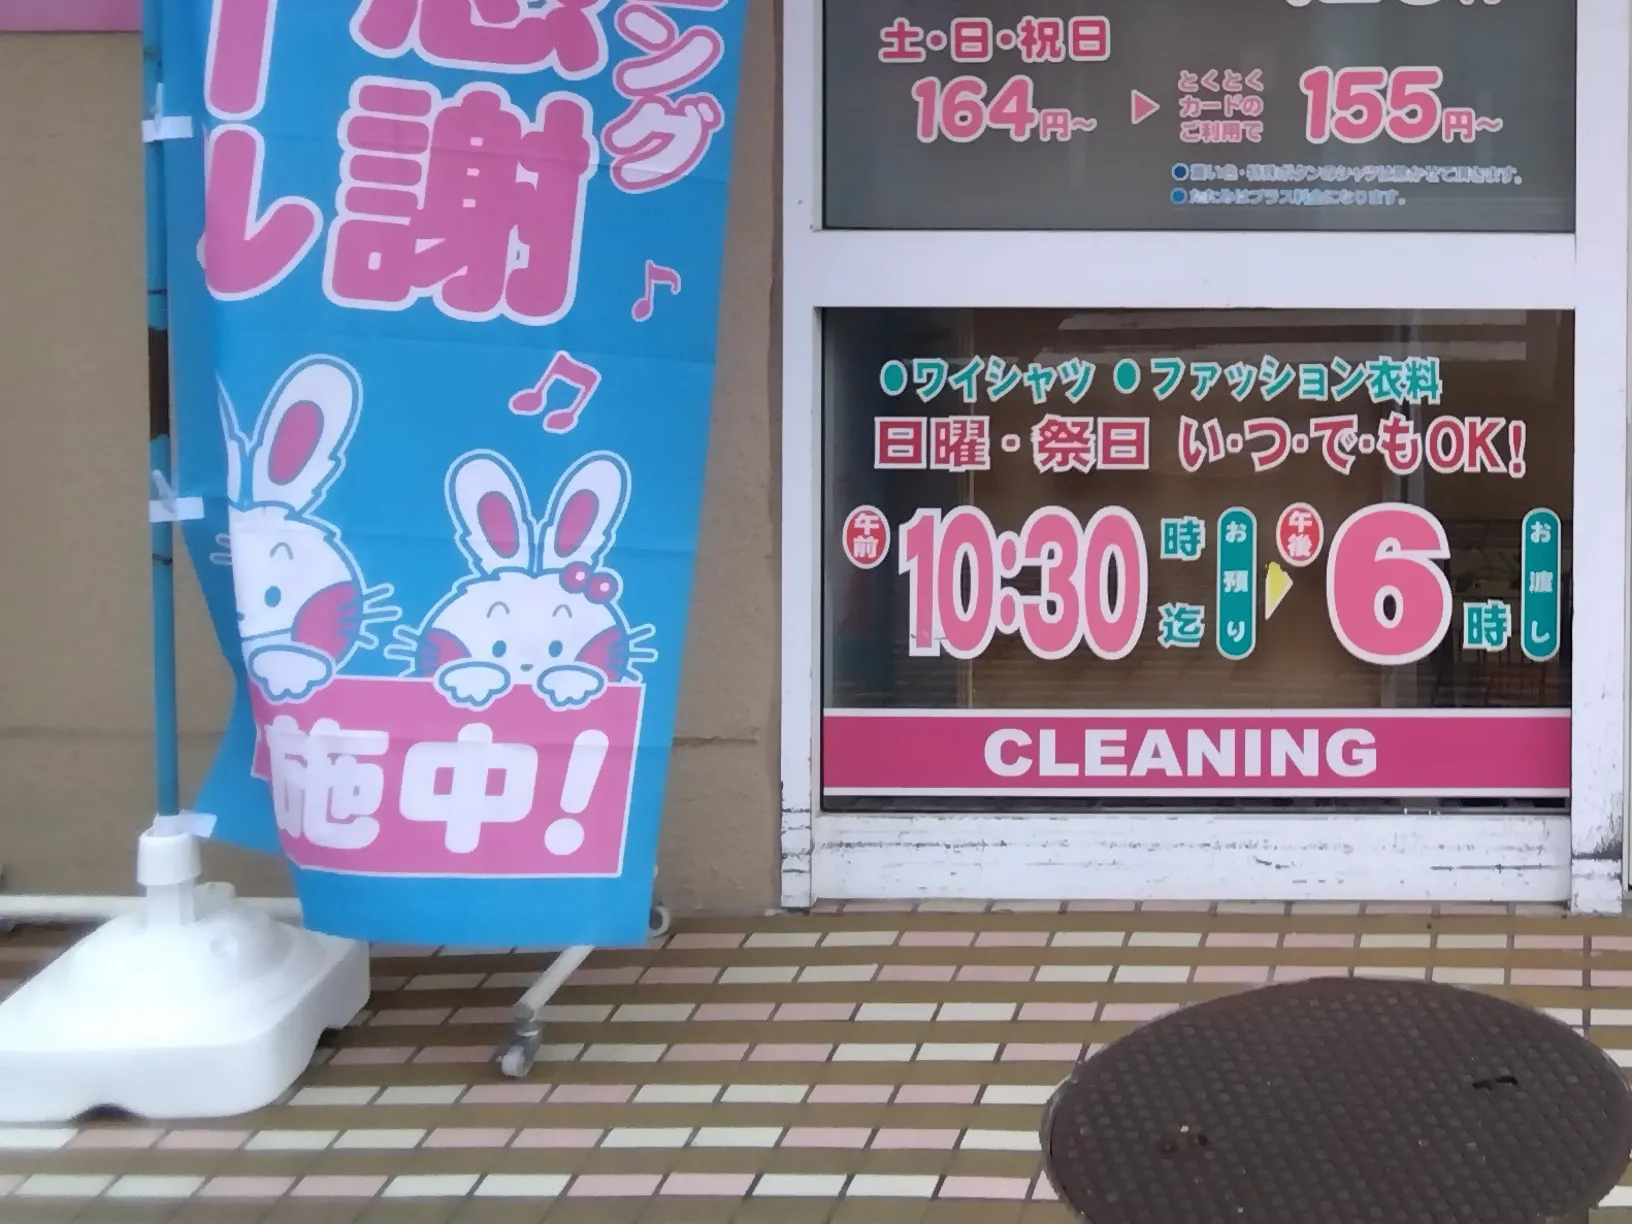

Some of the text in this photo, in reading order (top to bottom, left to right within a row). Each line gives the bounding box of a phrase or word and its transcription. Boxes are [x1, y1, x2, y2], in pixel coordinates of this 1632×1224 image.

[879, 15, 1111, 62] 土・日・祝日
[1177, 70, 1264, 92] とくとく
[1178, 93, 1263, 117] カードの
[1179, 119, 1263, 143] ご利用で
[911, 355, 1442, 406] ワイシャツ ファッション衣料
[874, 415, 1150, 473] 日曜・祭日
[851, 509, 882, 560] 午前
[899, 505, 1148, 660] 10:30
[1286, 508, 1313, 561] 午後
[983, 727, 1377, 778] CLEANING
